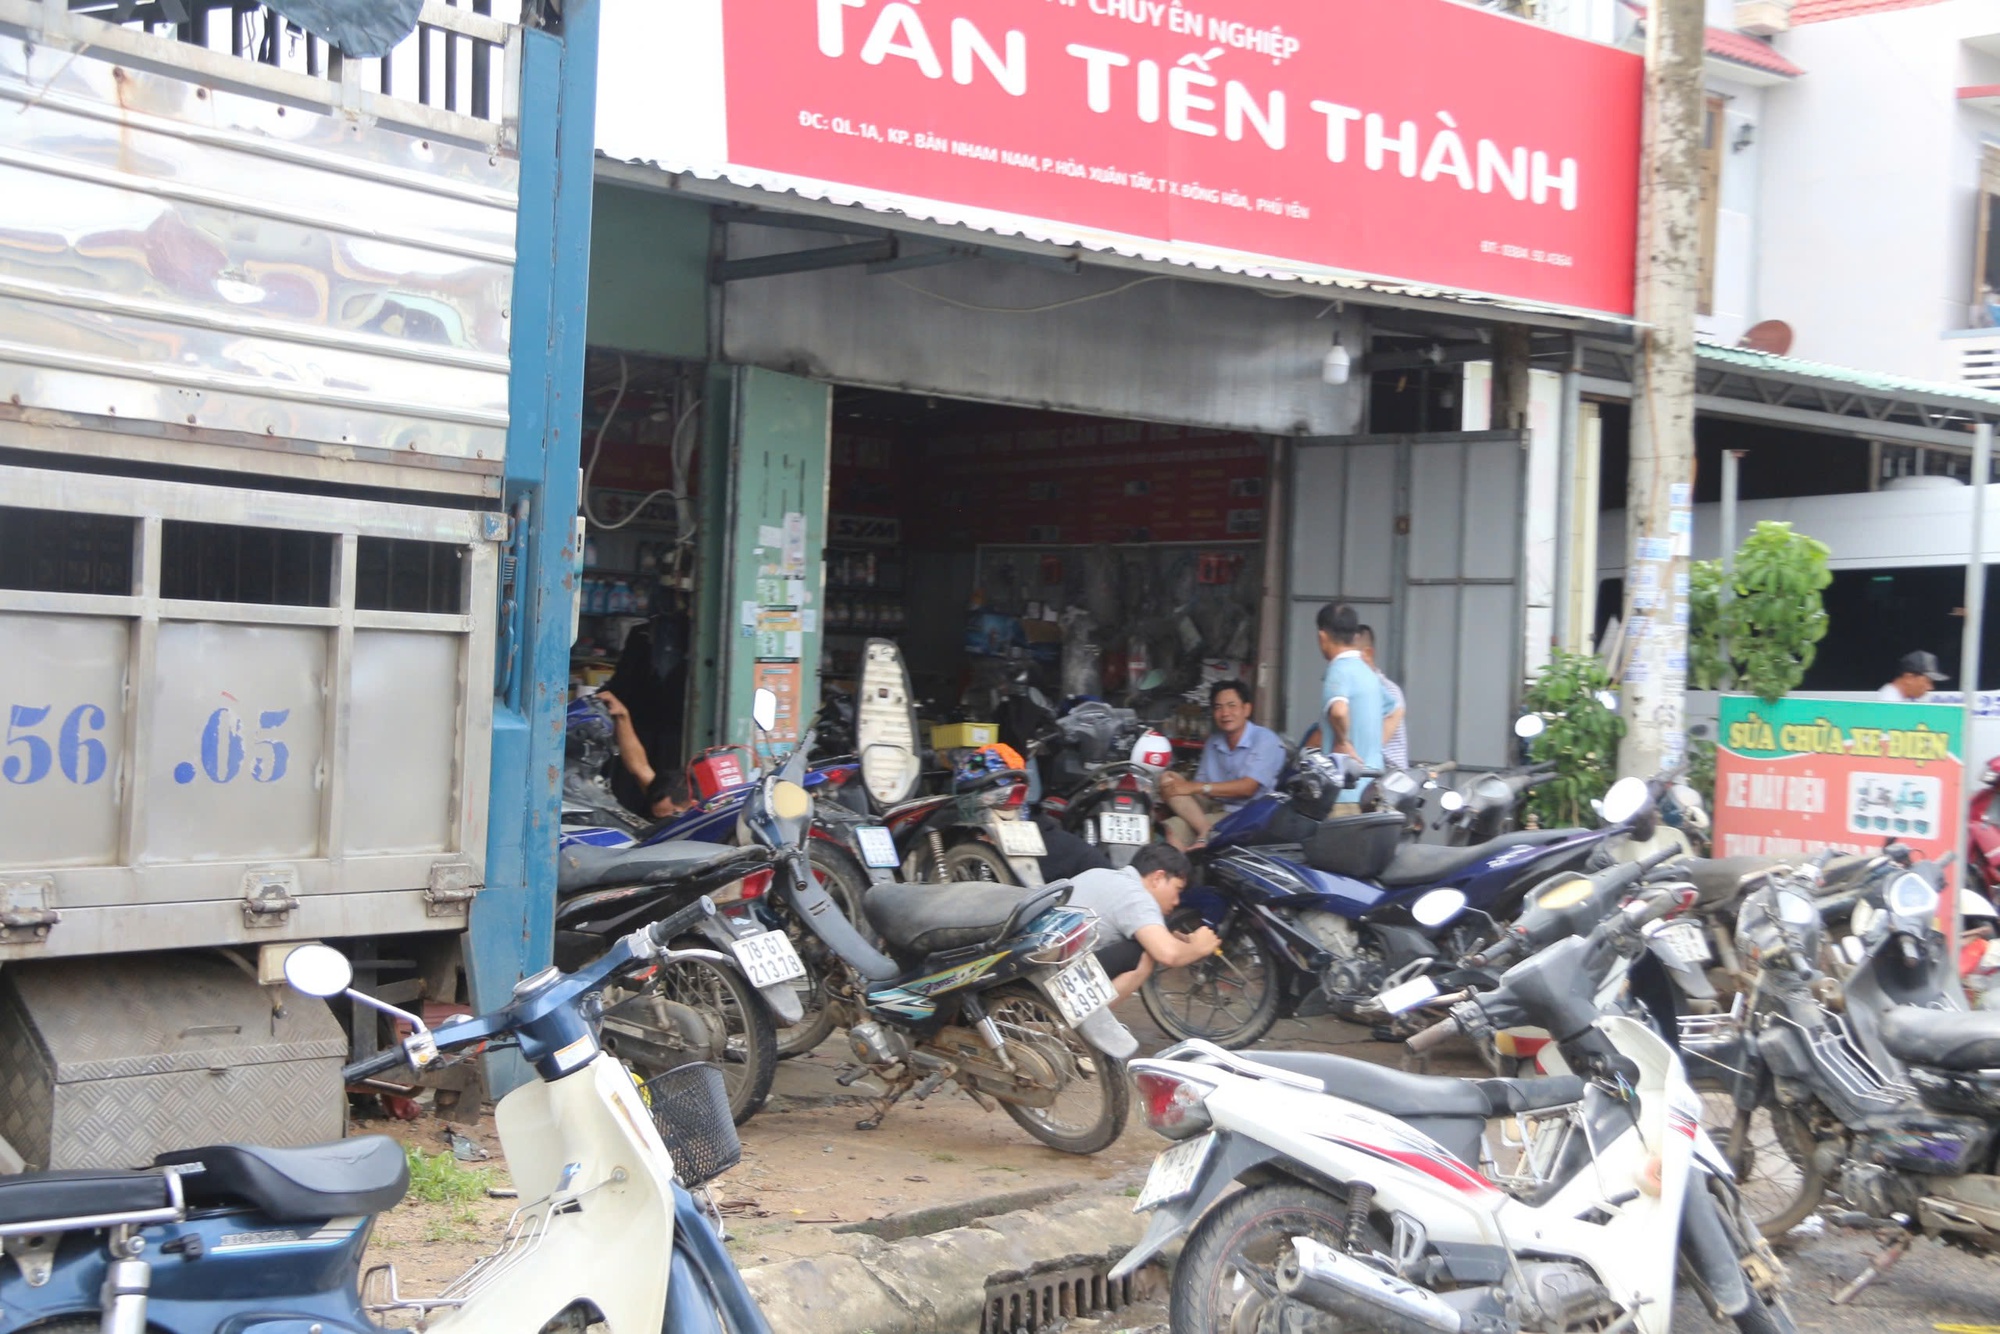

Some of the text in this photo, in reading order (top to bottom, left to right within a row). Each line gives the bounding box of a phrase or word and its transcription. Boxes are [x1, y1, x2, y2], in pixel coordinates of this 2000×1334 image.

[1209, 18, 1299, 65] NGHIỆP
[798, 110, 828, 130] ĐC:
[832, 117, 883, 142] QL.1A,
[951, 141, 998, 162] NHAM
[1066, 47, 1286, 150] TIẾN
[1310, 100, 1577, 211] THÀNH
[2, 703, 107, 785] 56
[1729, 711, 1776, 751] SỬA
[1779, 717, 1844, 755] CHỮA
[1850, 727, 1882, 757] XE
[749, 955, 801, 983] 213.78
